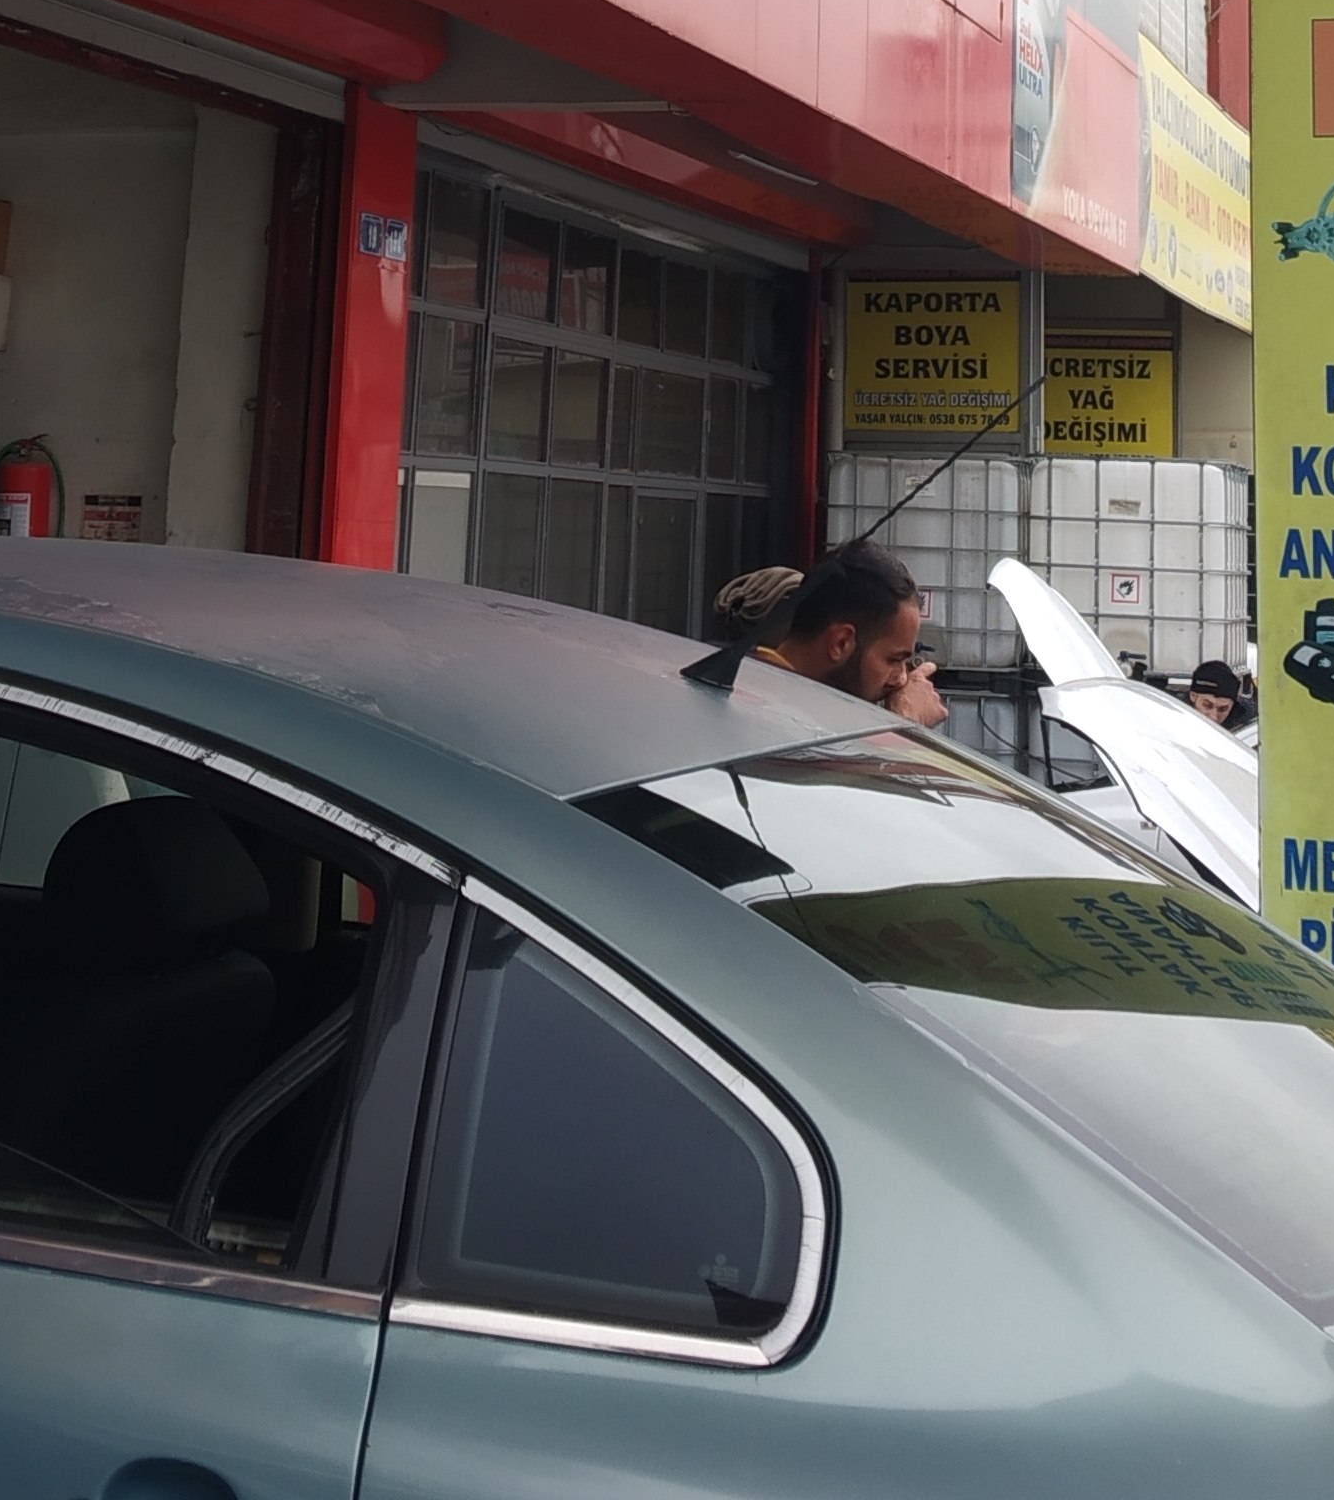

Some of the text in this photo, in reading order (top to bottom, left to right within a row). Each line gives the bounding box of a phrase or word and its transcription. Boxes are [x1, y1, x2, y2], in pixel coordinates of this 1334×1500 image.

[1019, 36, 1043, 76] HELIX
[1019, 63, 1042, 100] ULTRA
[864, 292, 1002, 313] KAPORTA
[894, 325, 970, 346] BOYA
[875, 353, 988, 379] SERVİSİ
[1045, 354, 1151, 379] CRETSİZ
[854, 389, 917, 406] ÜCRETSİZ
[921, 389, 946, 406] YAĞ
[1069, 385, 1114, 411] YAĞ
[930, 414, 955, 424] 0538
[959, 414, 977, 424] 675
